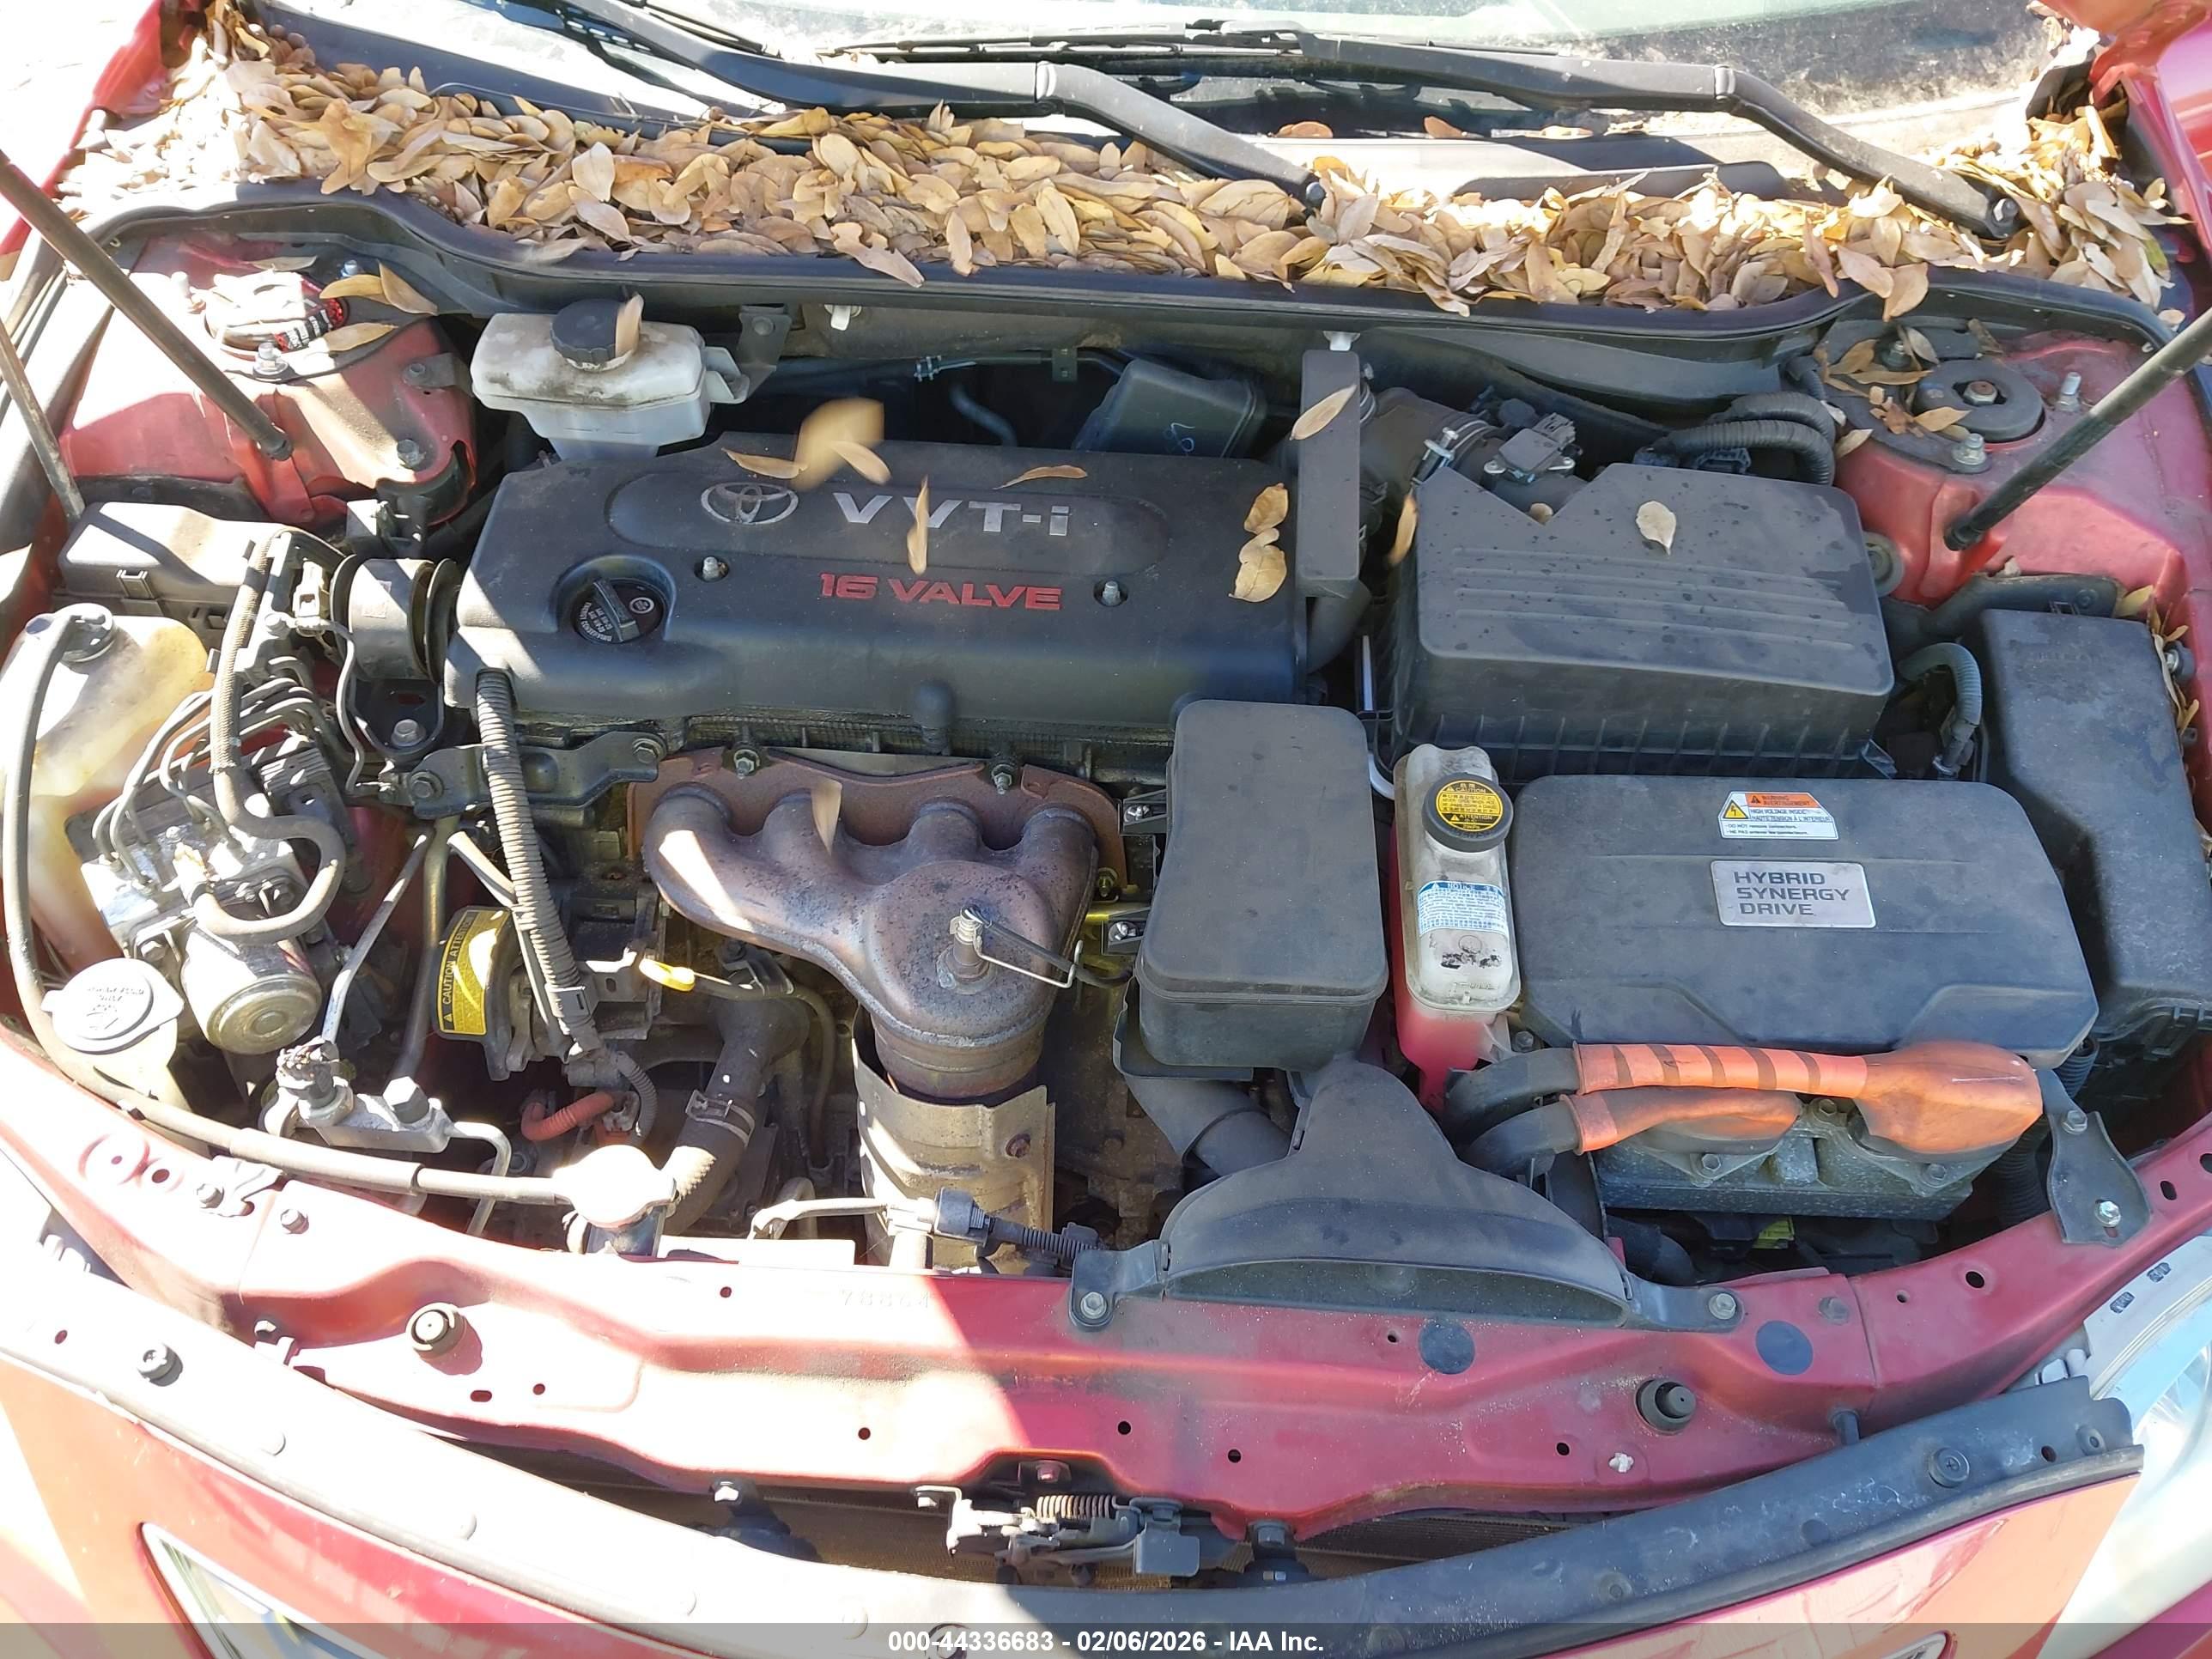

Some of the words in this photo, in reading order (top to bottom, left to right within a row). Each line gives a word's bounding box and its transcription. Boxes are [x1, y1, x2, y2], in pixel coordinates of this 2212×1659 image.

[832, 492, 1070, 537] VVT-i
[820, 573, 878, 599] 16
[888, 578, 1063, 611] VALVE
[1733, 871, 1826, 885] HYBRID
[1735, 886, 1850, 901] SYNERGY
[1739, 902, 1814, 915] DRIVE
[442, 961, 456, 1005] CAUTION
